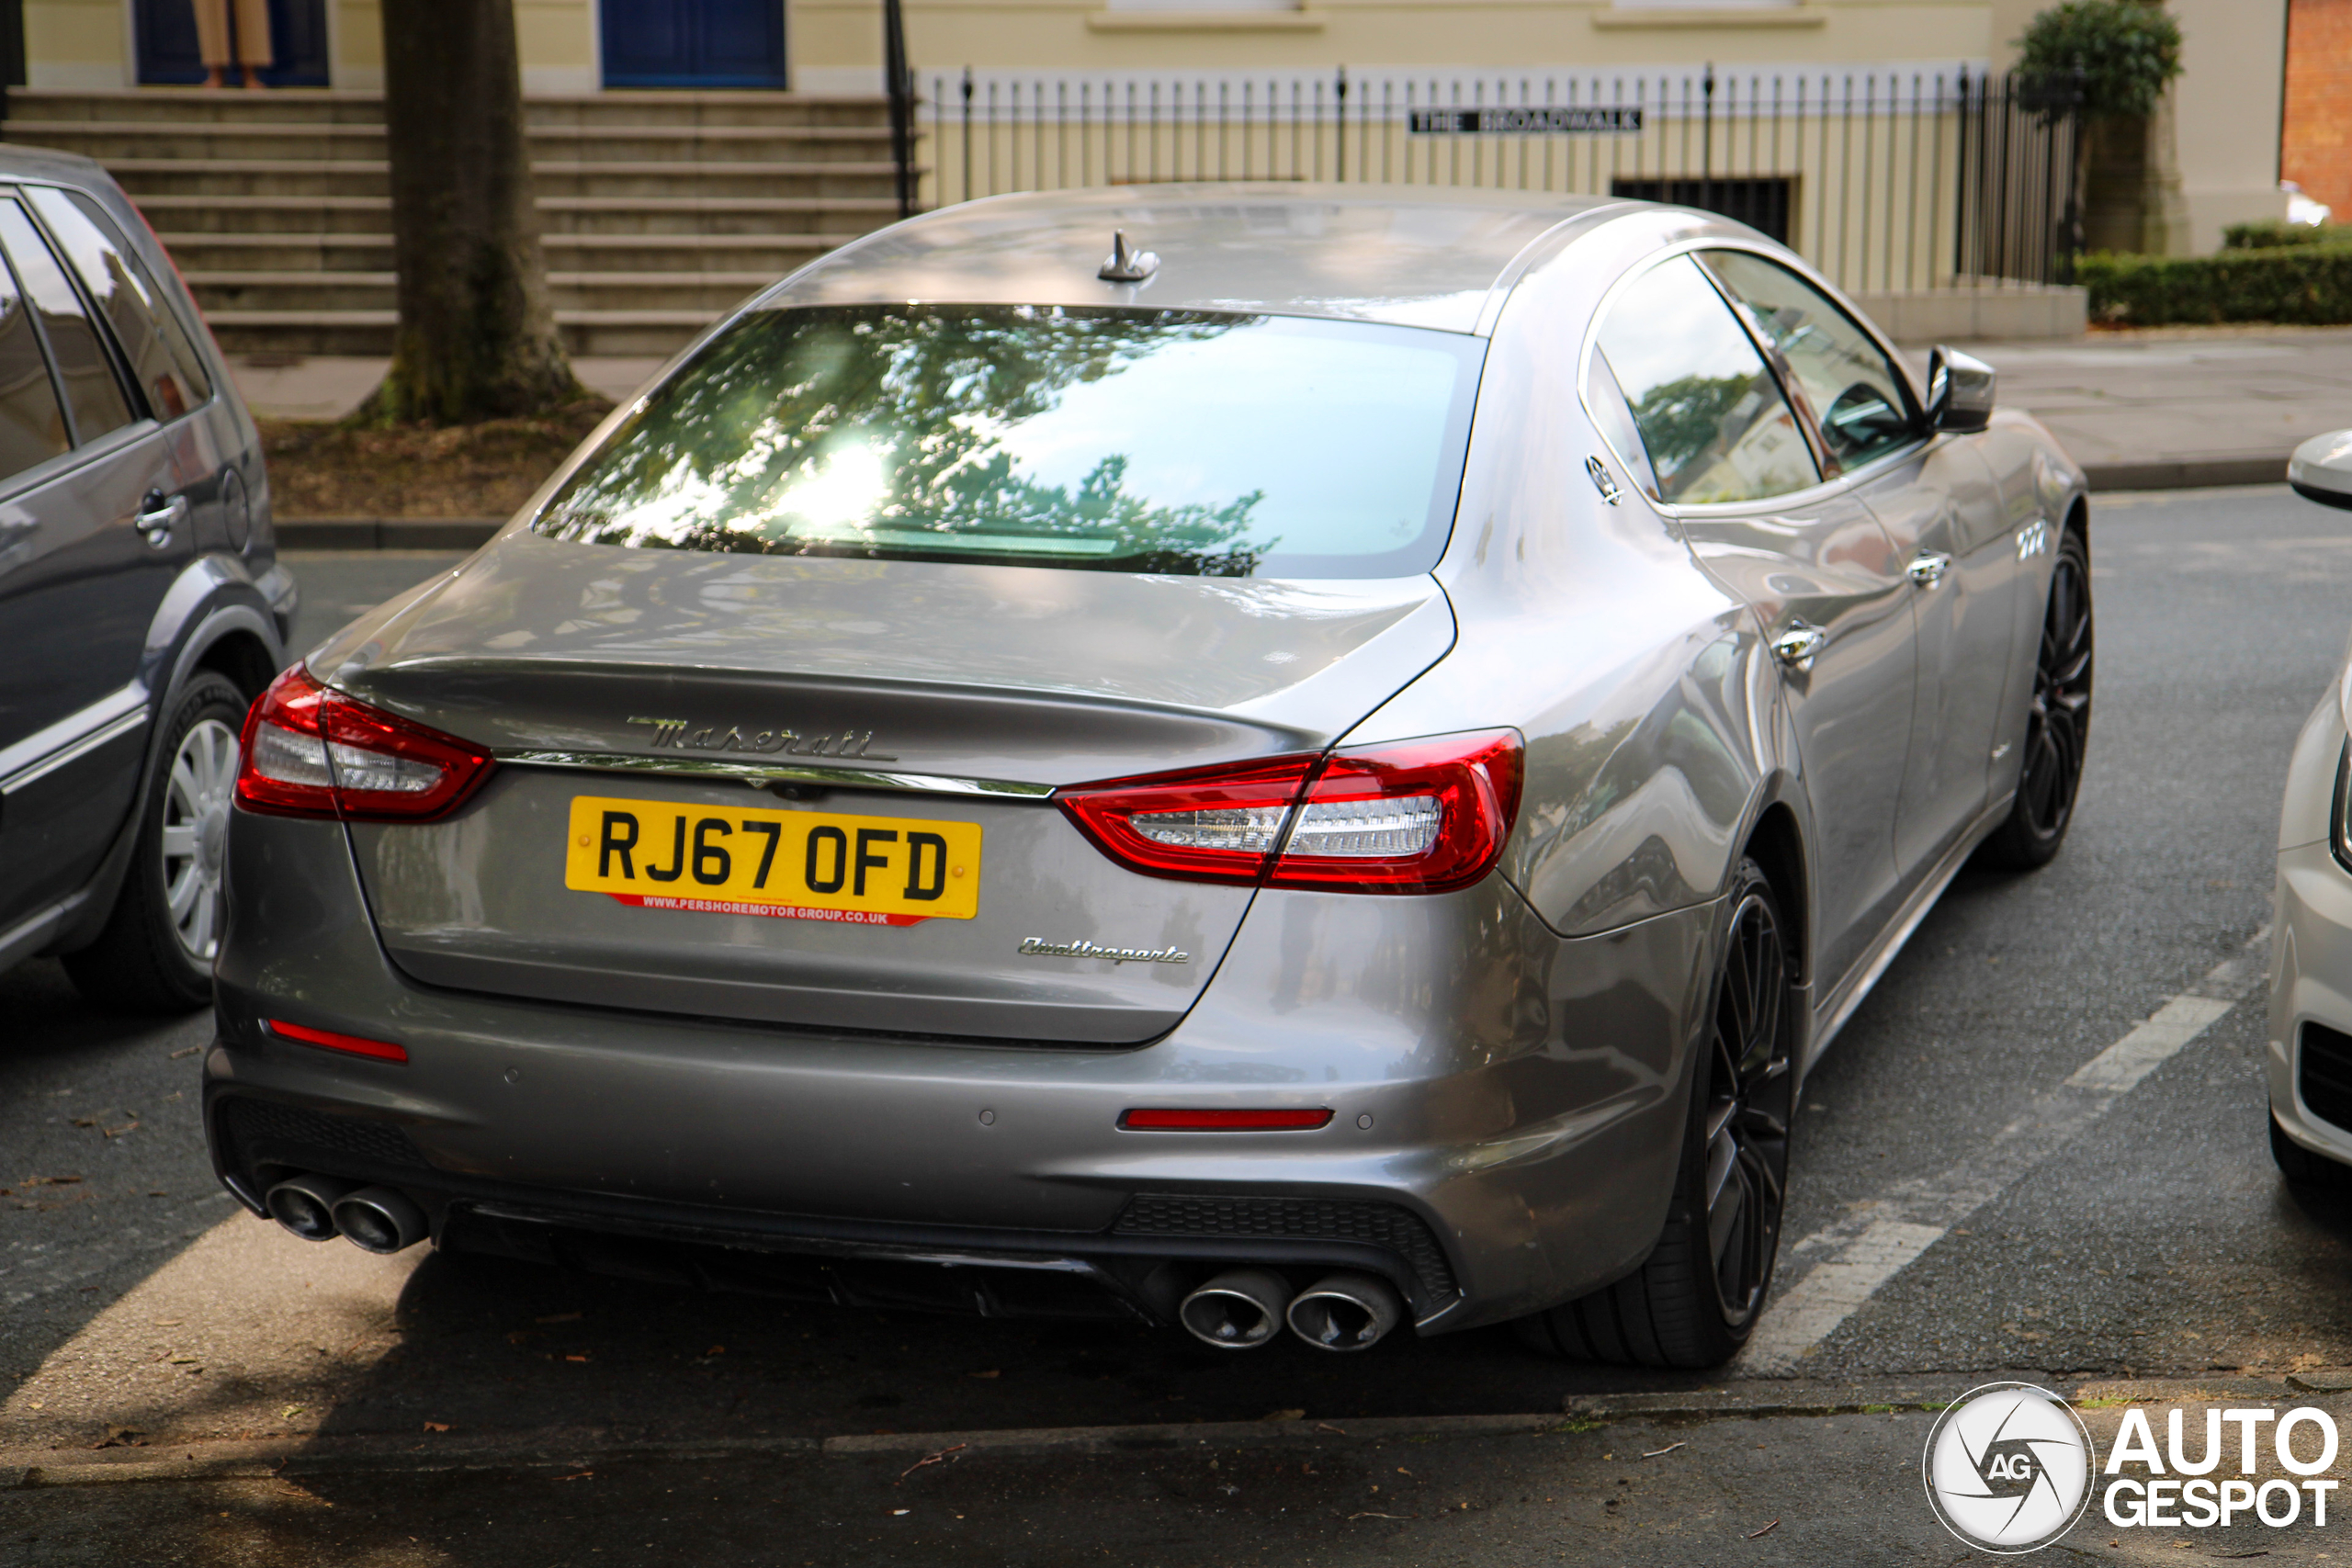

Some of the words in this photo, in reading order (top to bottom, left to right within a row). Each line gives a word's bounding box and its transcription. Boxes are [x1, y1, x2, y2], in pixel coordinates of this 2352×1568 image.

[1417, 111, 1465, 131] THE
[1479, 109, 1640, 131] BROADWALK
[627, 716, 898, 761] Maserati
[598, 810, 781, 889] RJ67
[805, 826, 947, 901] OFD
[1018, 937, 1189, 964] Quattroporte
